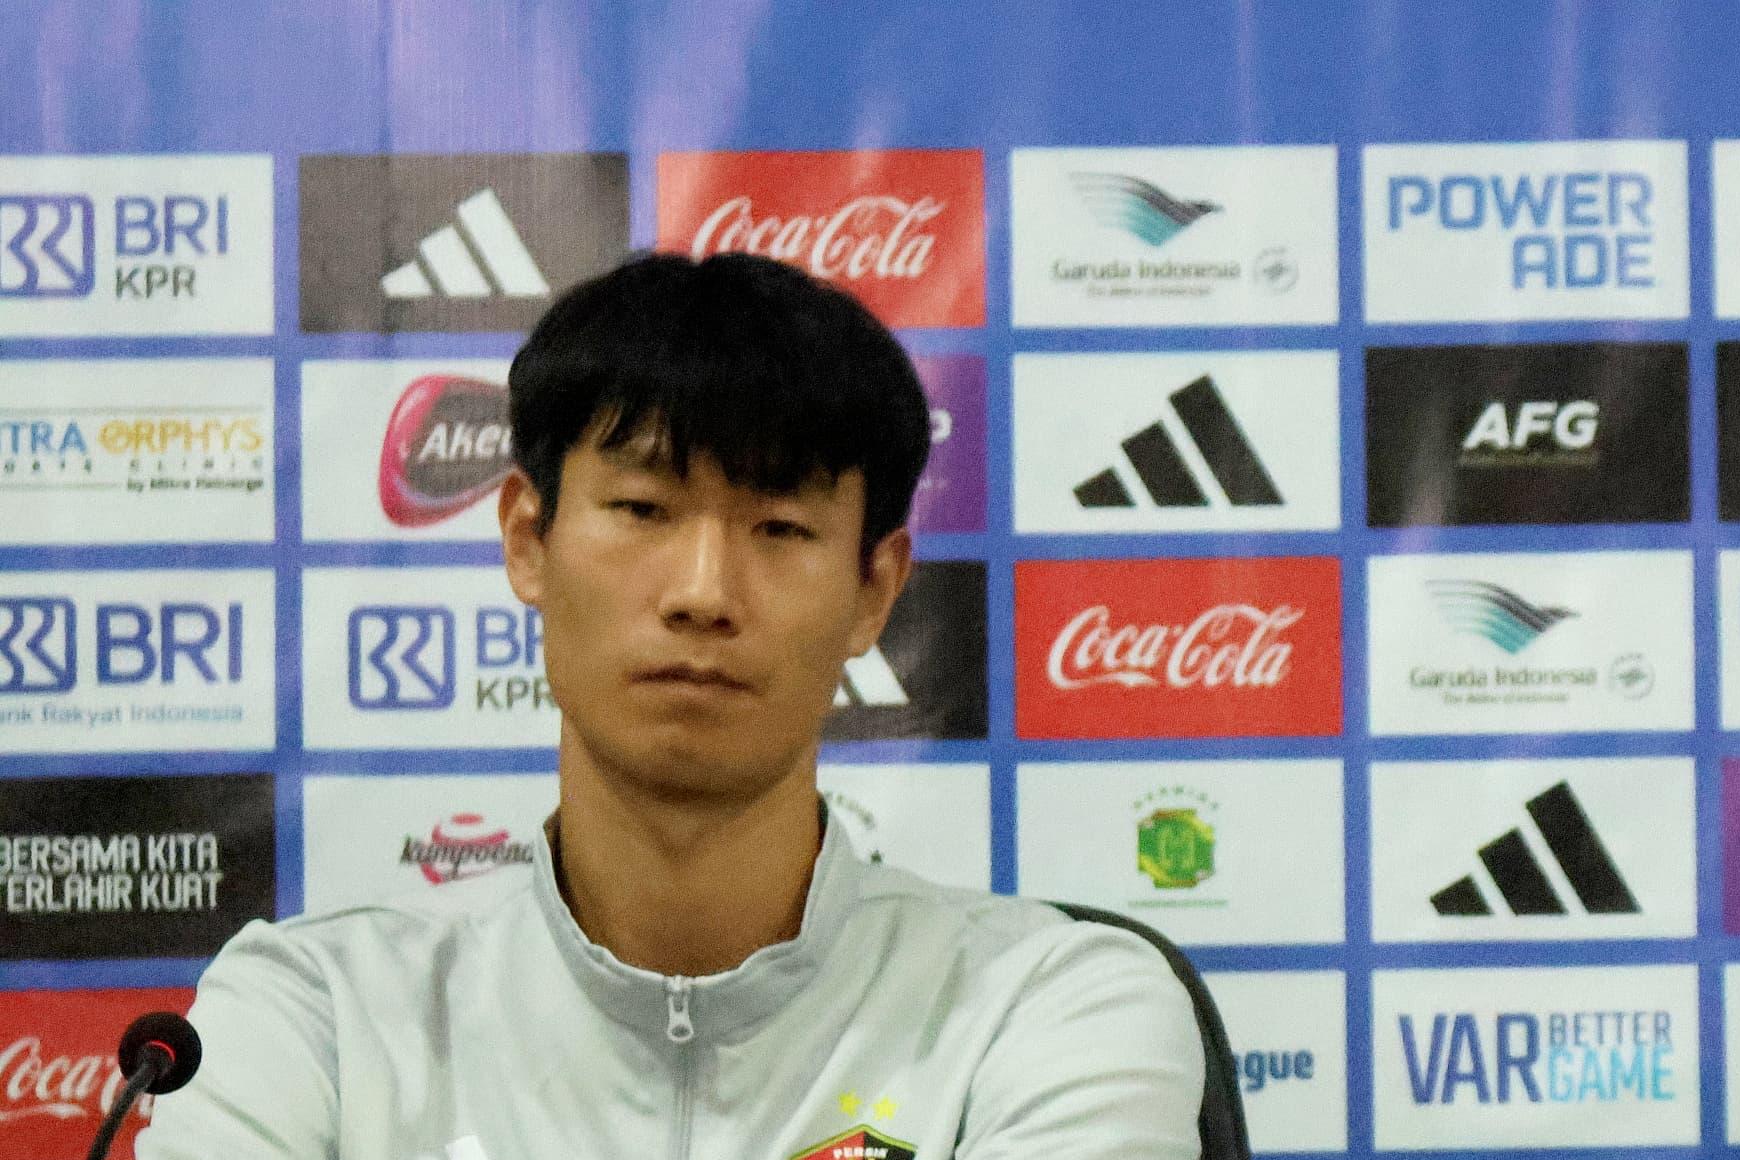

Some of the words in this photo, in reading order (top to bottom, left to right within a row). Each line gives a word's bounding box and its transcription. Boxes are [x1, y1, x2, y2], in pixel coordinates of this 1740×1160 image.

[1388, 172, 1655, 231] POWER
[115, 195, 228, 257] BRI
[115, 266, 195, 298] KPR
[1512, 235, 1655, 290] ADE
[0, 418, 87, 454] TRA
[1462, 400, 1600, 449] AFG
[96, 603, 242, 684] BRI
[1410, 666, 1487, 687] Garuda
[1495, 666, 1597, 685] Indonesia
[42, 704, 122, 728] Rakyat
[131, 704, 243, 721] Indonesia
[148, 831, 219, 872] KITA
[0, 872, 133, 913] ERLAHIR
[140, 870, 224, 911] KUAT
[1549, 1011, 1671, 1045] BETTER
[1398, 1011, 1545, 1106] VAR
[1548, 1044, 1673, 1101] GAME
